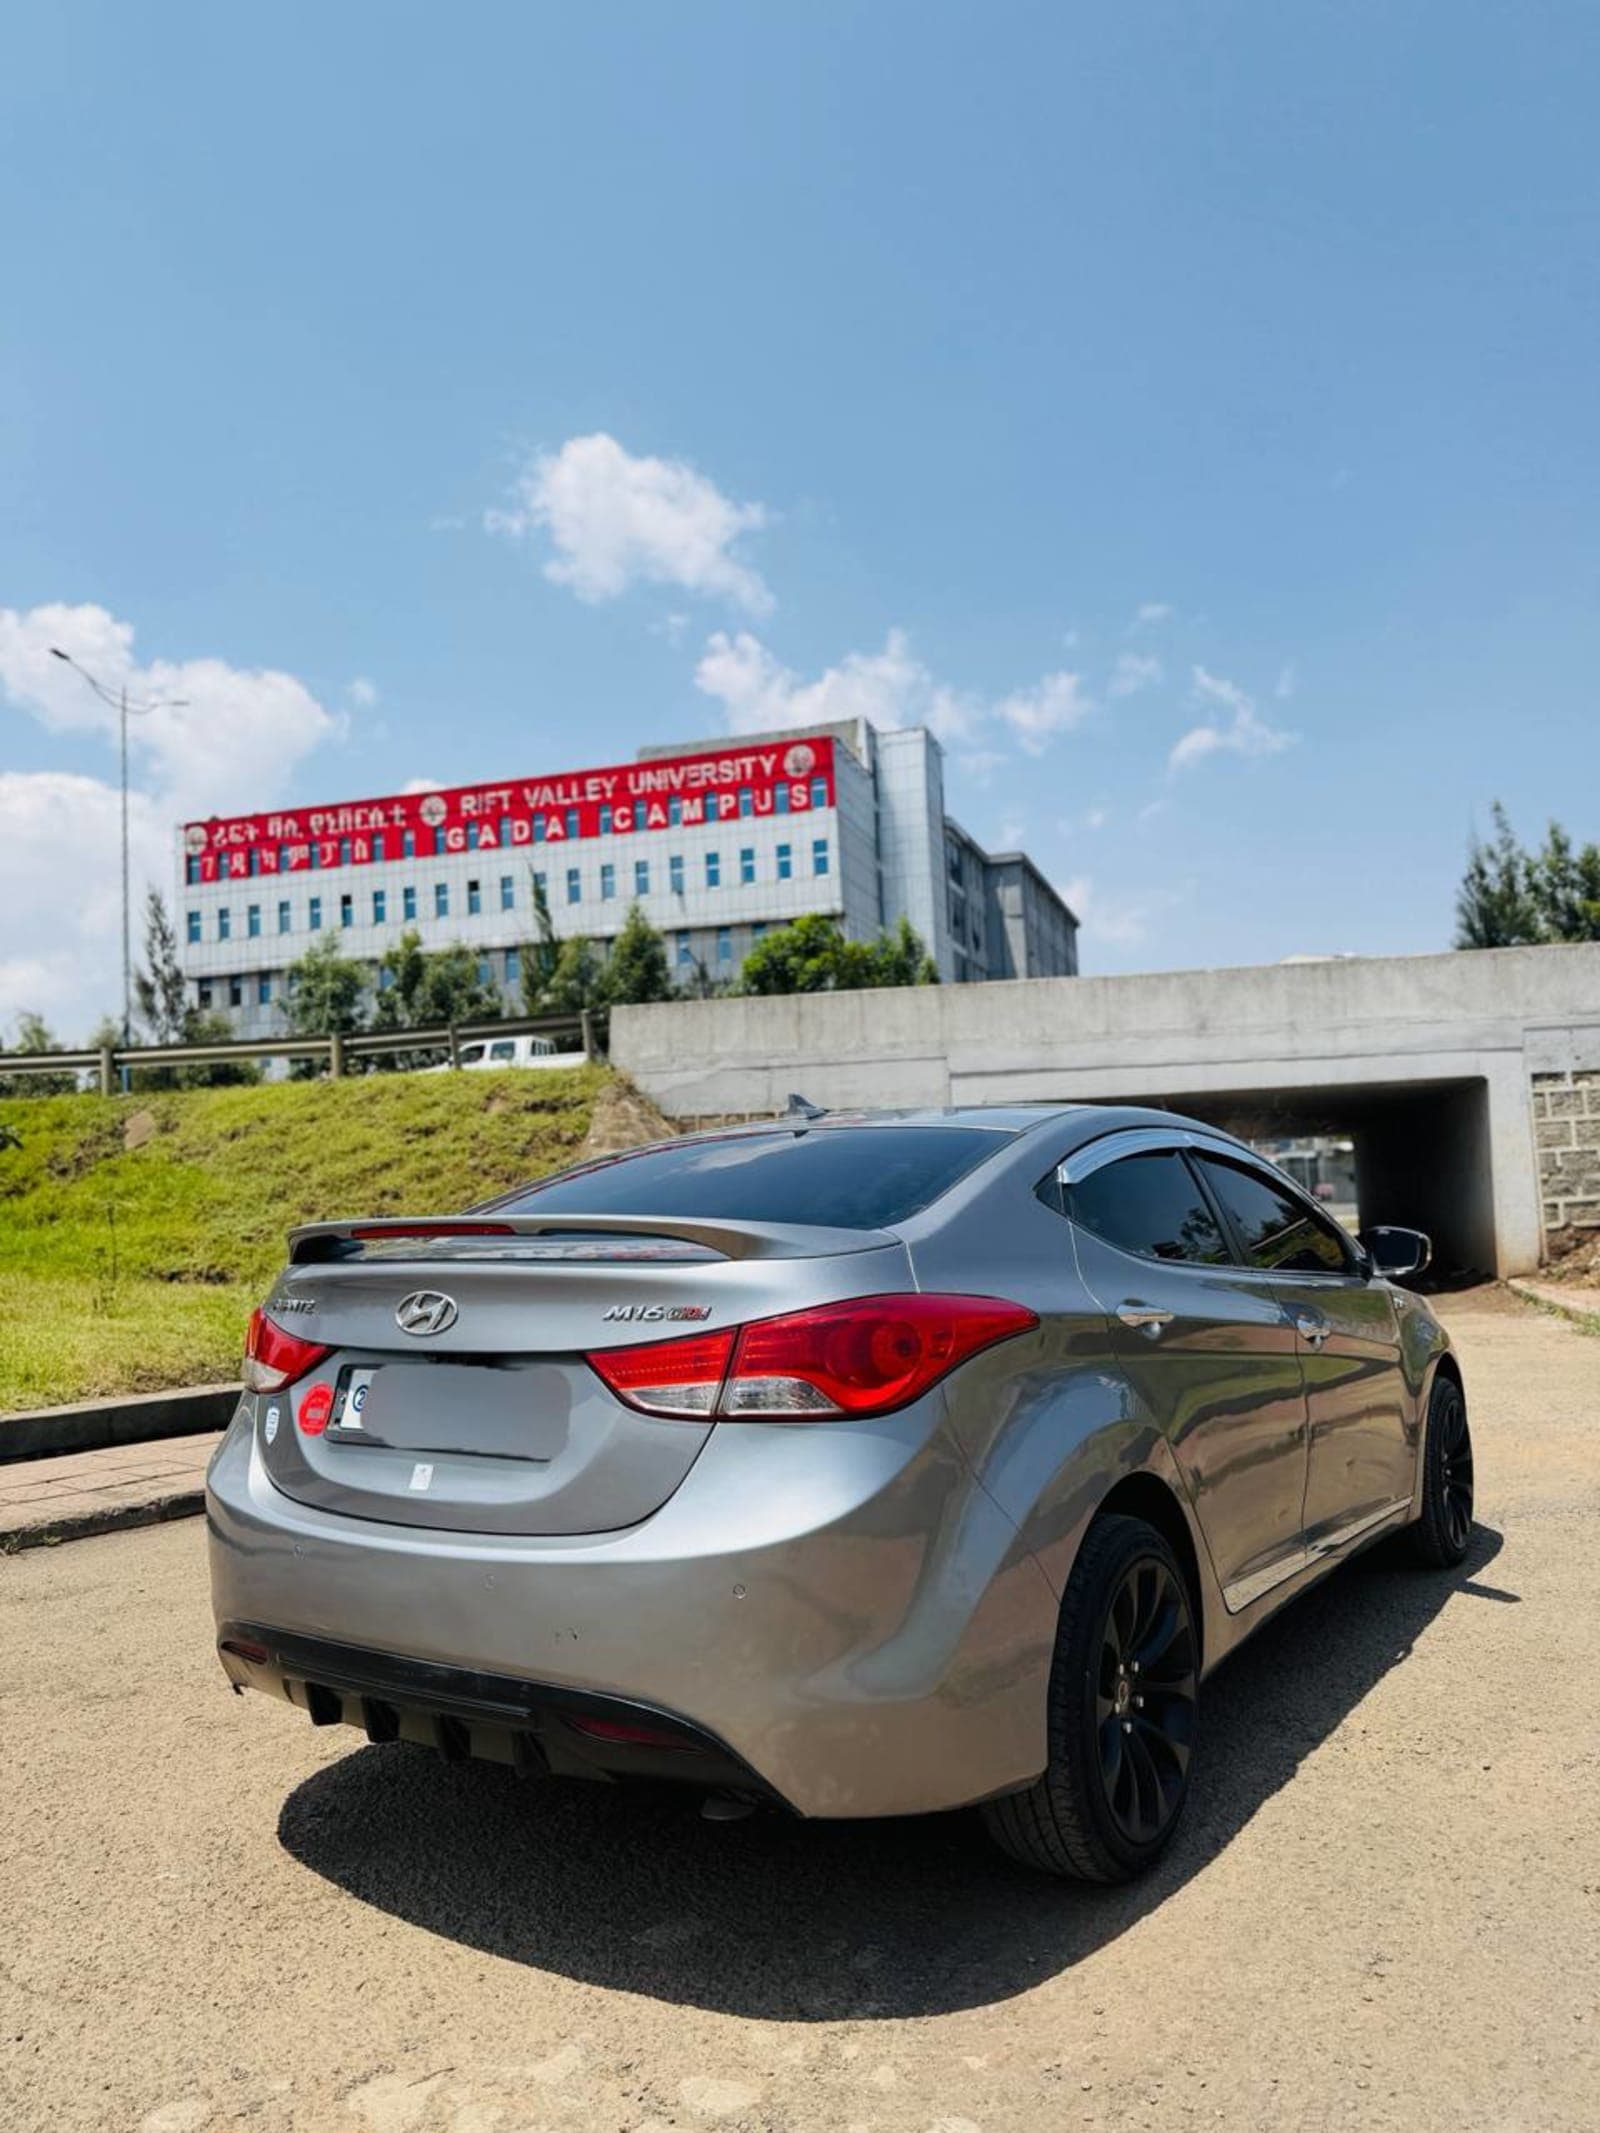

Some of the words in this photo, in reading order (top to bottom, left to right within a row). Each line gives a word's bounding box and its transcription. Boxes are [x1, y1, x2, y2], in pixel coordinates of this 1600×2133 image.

[461, 790, 512, 816] RIFT
[524, 775, 617, 808] VALLEY
[628, 754, 777, 793] UNIVERSITY
[446, 816, 564, 848] GADA
[614, 785, 808, 829] CAMPUS
[602, 1304, 664, 1321] M16
